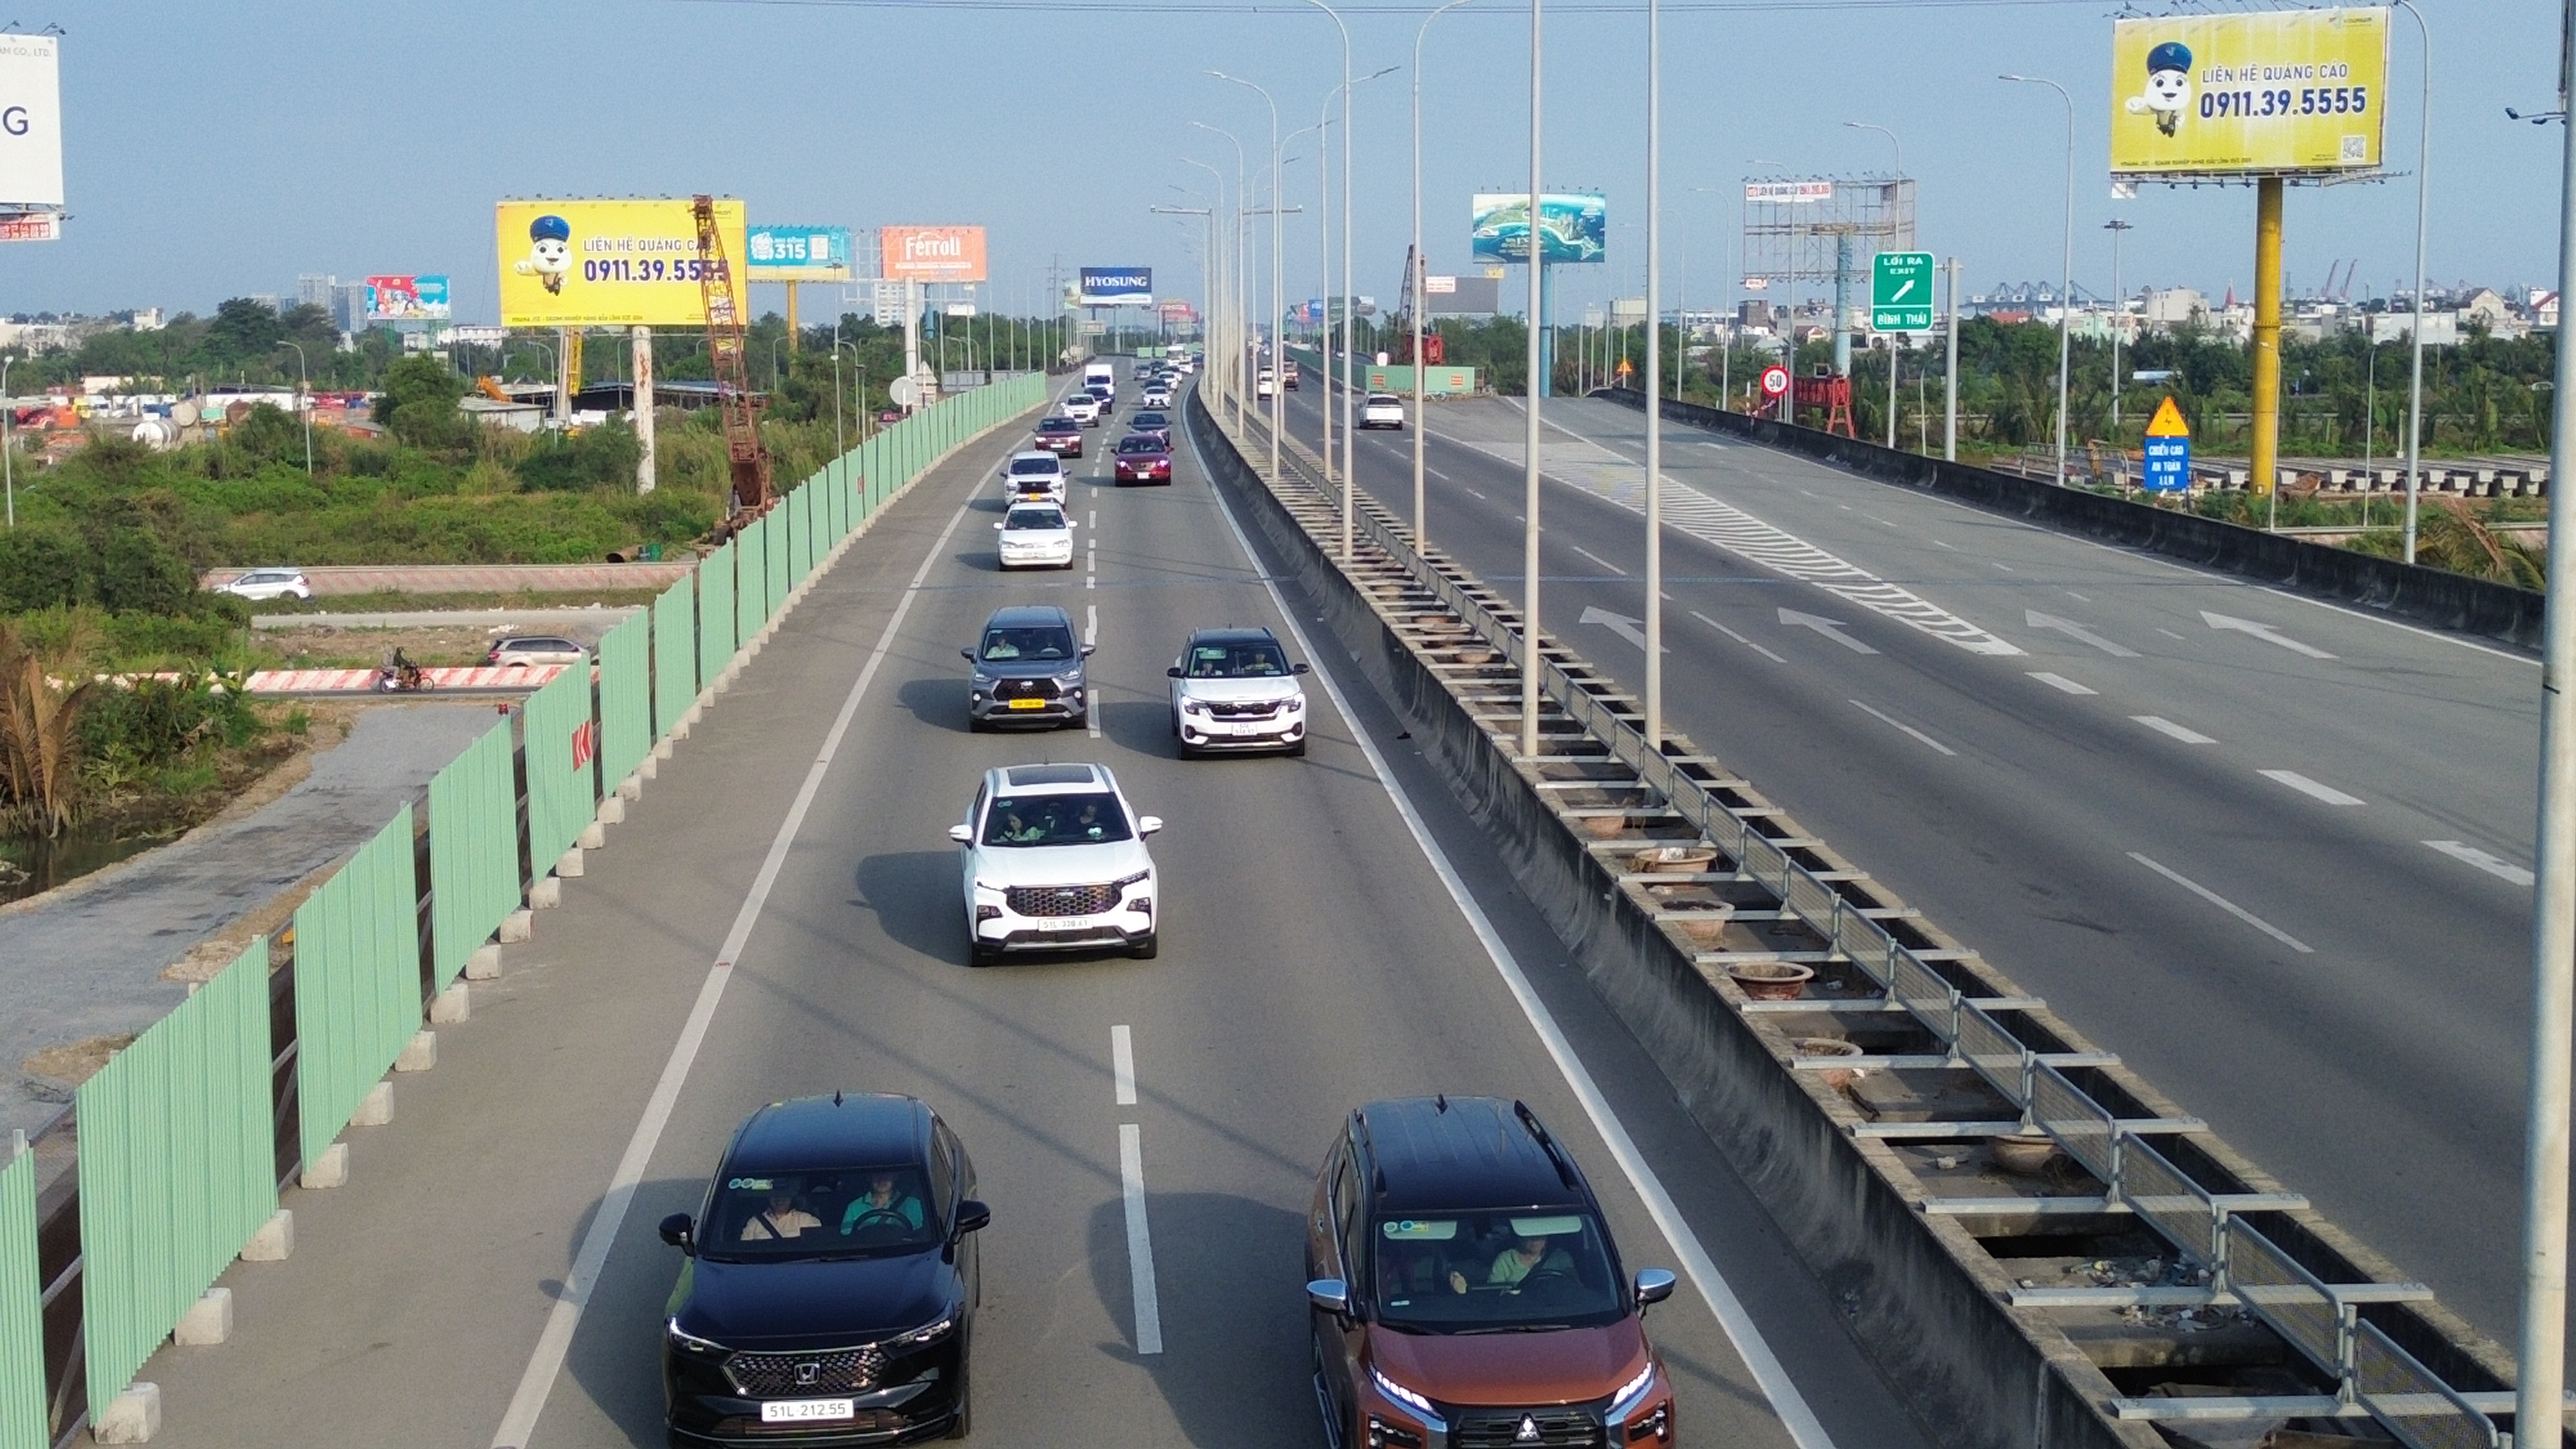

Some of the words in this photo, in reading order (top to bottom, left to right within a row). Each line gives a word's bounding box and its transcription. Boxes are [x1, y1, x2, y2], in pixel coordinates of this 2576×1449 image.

[2202, 65, 2233, 83] LIÊN
[2320, 60, 2348, 79] CÁO
[2200, 87, 2366, 118] 0911.39.5555
[583, 236, 612, 252] LIÊN
[775, 243, 806, 259] 315
[905, 235, 960, 260] Ferroli
[1907, 256, 1924, 265] RA
[1084, 276, 1148, 287] HYOSUNG
[1769, 374, 1782, 388] 50
